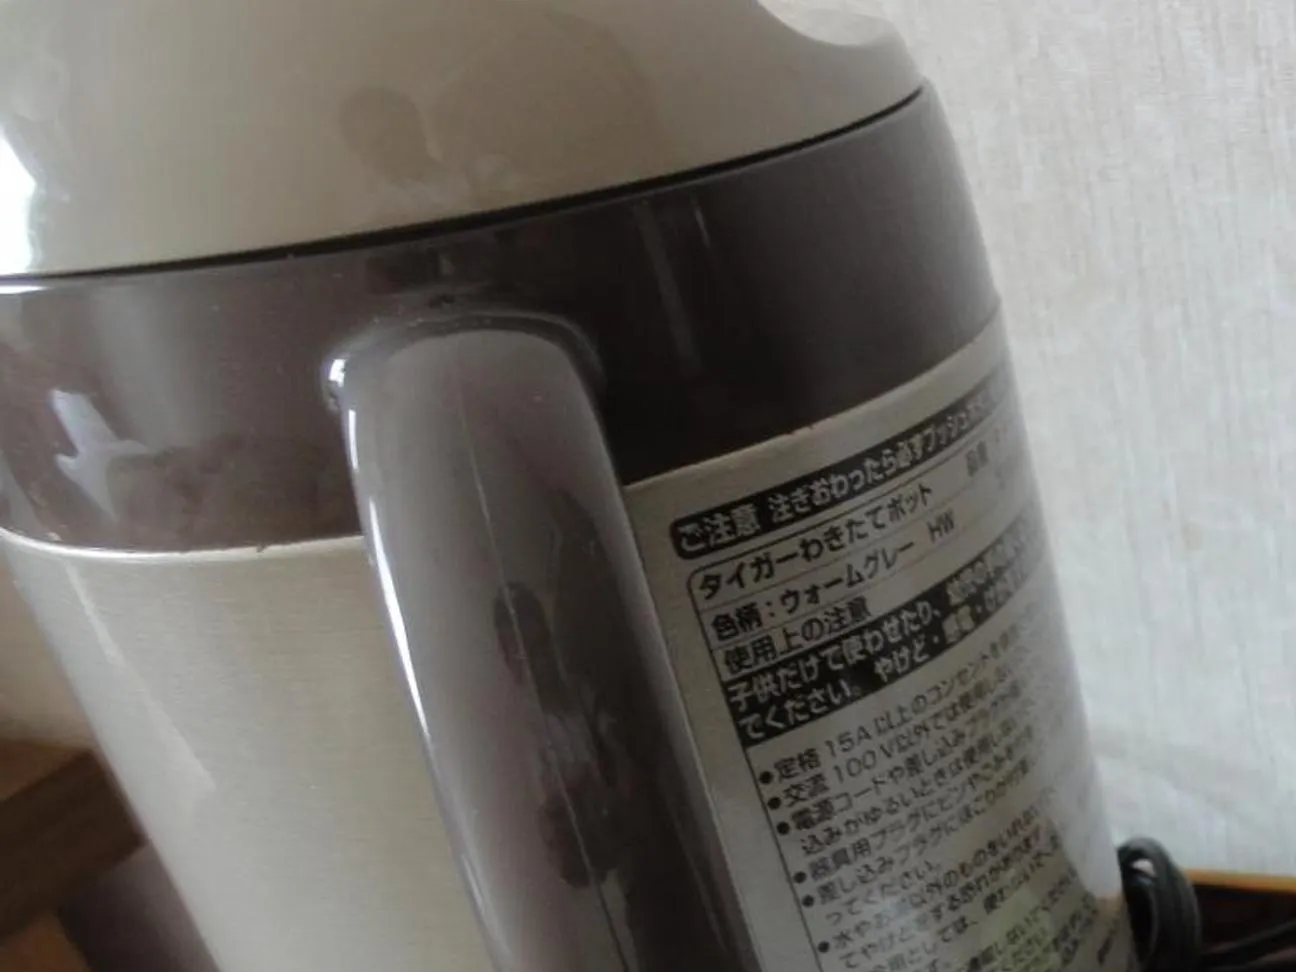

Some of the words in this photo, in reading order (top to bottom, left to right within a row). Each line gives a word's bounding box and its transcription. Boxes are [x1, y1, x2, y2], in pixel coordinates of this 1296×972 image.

[676, 500, 761, 559] ご注意
[696, 476, 935, 603] タイガーわきたてポット
[722, 591, 871, 677] 使用上の注意
[772, 744, 821, 784] 定格
[780, 770, 830, 810] 交流
